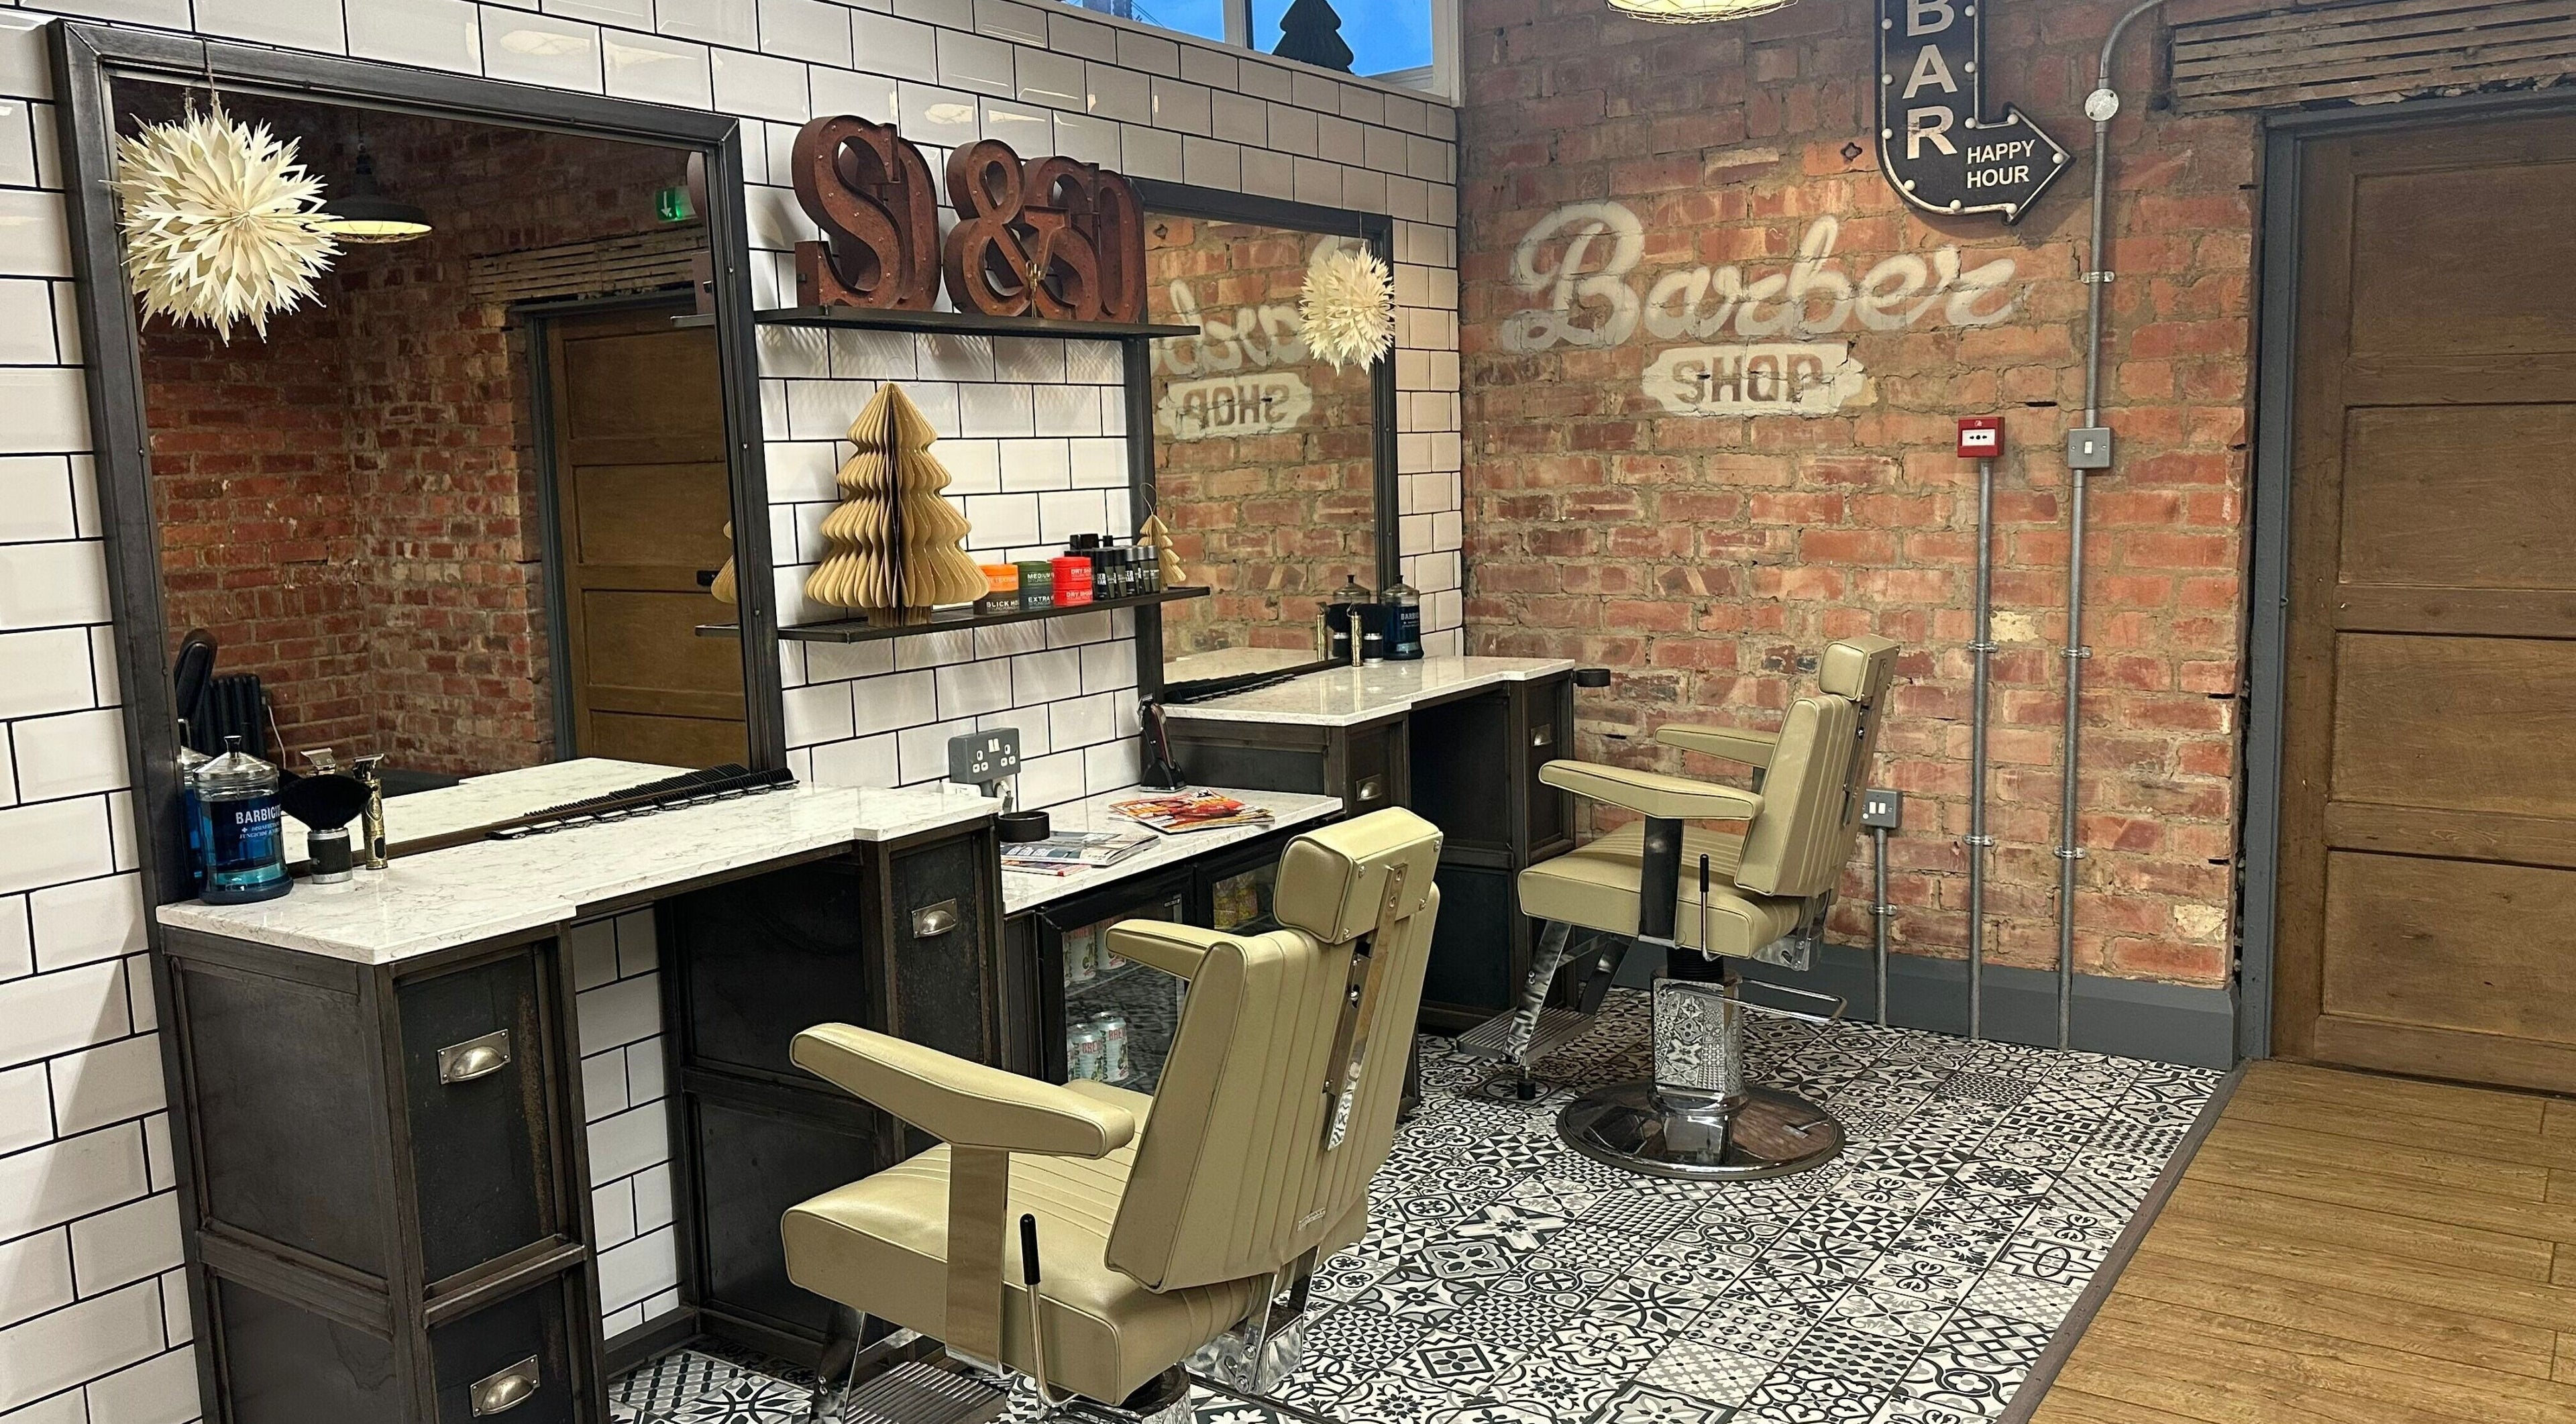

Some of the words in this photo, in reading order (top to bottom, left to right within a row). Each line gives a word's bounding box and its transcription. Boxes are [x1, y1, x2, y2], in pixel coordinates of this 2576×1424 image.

[1902, 0, 1957, 160] BAR
[1967, 140, 2035, 164] HAPPY
[1967, 166, 2030, 188] HOUR
[944, 139, 1071, 317] &
[1501, 201, 2018, 351] Barber
[1672, 353, 1824, 404] SHOP
